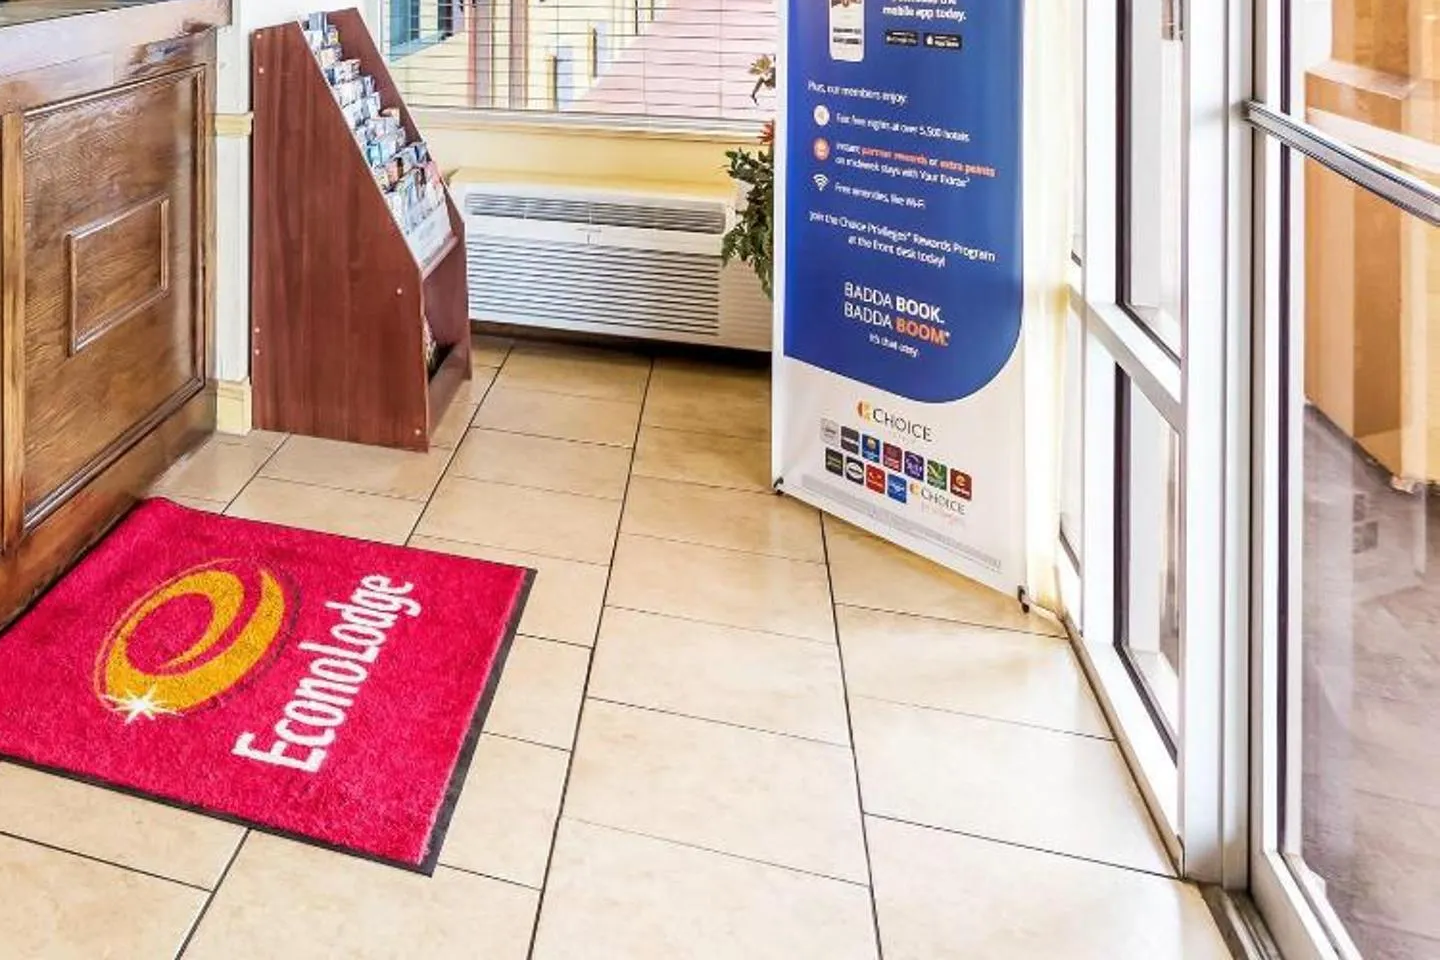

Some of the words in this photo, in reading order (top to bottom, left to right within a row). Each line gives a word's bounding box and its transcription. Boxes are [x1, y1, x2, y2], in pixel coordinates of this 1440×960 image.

[882, 5, 915, 16] mobile
[915, 7, 934, 20] app
[935, 7, 967, 22] today.
[809, 210, 825, 223] Join
[825, 212, 838, 225] the
[838, 216, 867, 232] Choice
[953, 241, 996, 263] Program
[847, 235, 857, 246] at
[857, 236, 873, 250] the
[873, 238, 895, 255] front
[895, 244, 917, 259] desk
[844, 281, 894, 310] BADDA
[895, 295, 945, 324] BOOK.
[844, 301, 894, 330] BADDA
[872, 407, 933, 442] CHOICE
[920, 487, 966, 516] CHOICE
